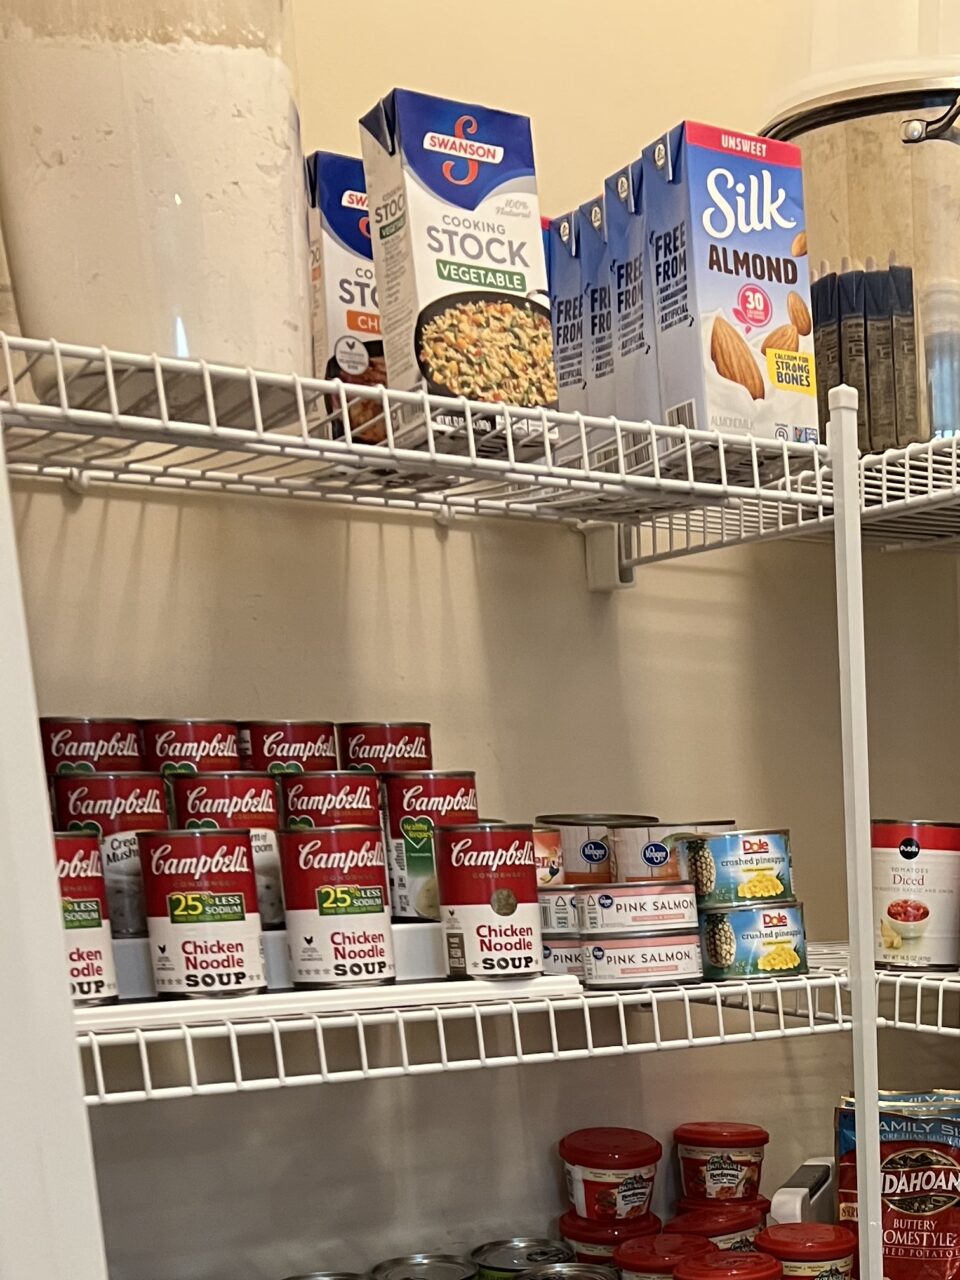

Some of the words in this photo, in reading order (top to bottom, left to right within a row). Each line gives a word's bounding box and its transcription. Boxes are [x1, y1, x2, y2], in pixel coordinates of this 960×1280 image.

[429, 135, 497, 160] SWANSON
[721, 133, 768, 158] UNSWEET
[702, 168, 798, 239] Silk
[442, 214, 507, 236] COOKING
[425, 225, 531, 269] STOCK
[655, 220, 687, 262] FREE
[616, 252, 644, 290] FREE
[655, 248, 688, 287] FROM
[708, 244, 798, 285] ALMOND
[438, 260, 524, 290] VEGETABLE
[616, 280, 644, 314] FROM
[743, 291, 764, 311] 30
[556, 293, 584, 325] FREE
[556, 318, 584, 346] FROM
[774, 361, 811, 376] STRONG
[775, 371, 811, 388] BONES
[742, 838, 769, 853] Dole
[720, 856, 754, 868] crushed
[892, 873, 926, 887] Diced
[171, 891, 215, 916] 25%
[214, 894, 241, 906] LESS
[319, 884, 361, 908] 25%
[360, 888, 381, 898] LESS
[73, 901, 98, 912] LESS
[204, 904, 242, 915] SODIUM
[615, 901, 647, 914] PINK
[651, 899, 696, 912] SALMON
[762, 913, 788, 928] Dole
[329, 930, 385, 947] Chicken
[475, 924, 533, 939] Chicken
[741, 930, 774, 941] crushed
[181, 940, 245, 956] Chicken
[333, 944, 386, 961] Noodle
[479, 937, 533, 953] Noodle
[184, 954, 245, 971] Noodle
[482, 955, 534, 970] SOUP
[552, 953, 583, 965] PINK
[606, 953, 636, 965] PINK
[640, 951, 692, 964] SALMON
[333, 961, 387, 977] SOUP
[185, 972, 247, 988] SOUP
[893, 1218, 937, 1231] BUTTERY
